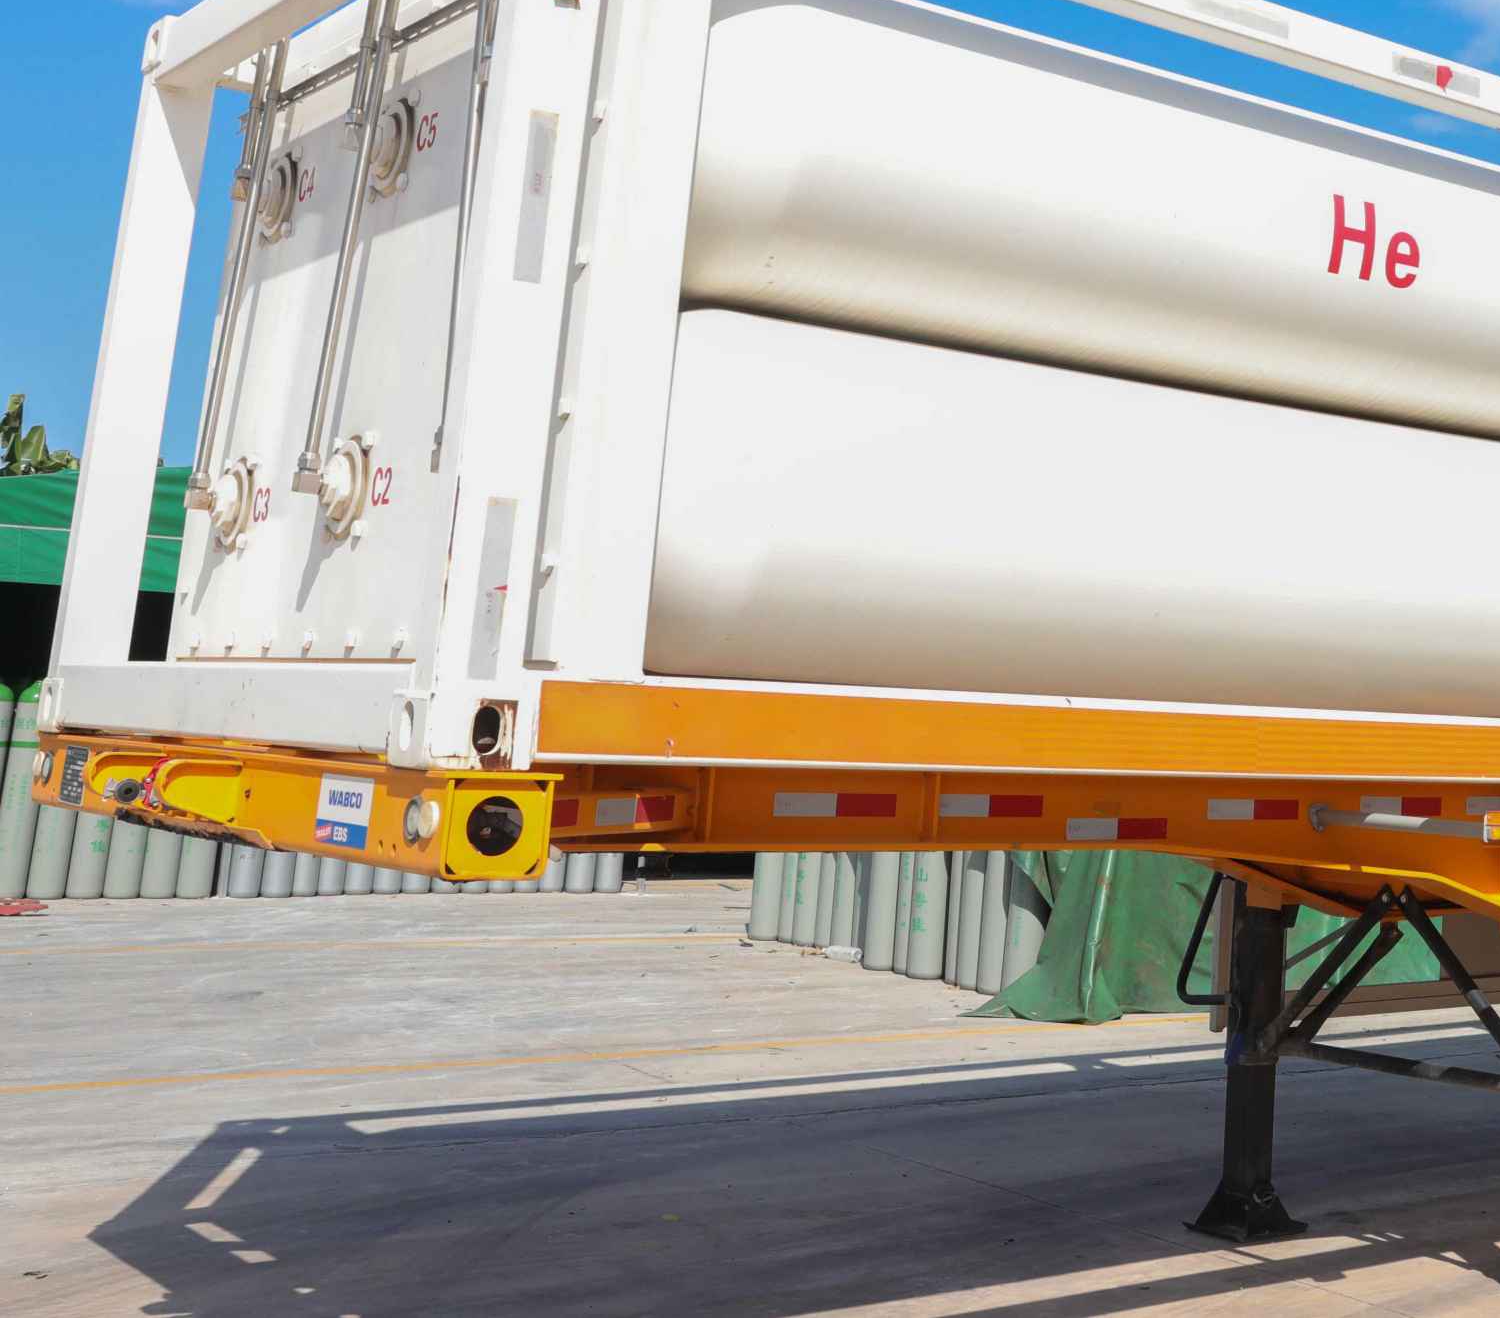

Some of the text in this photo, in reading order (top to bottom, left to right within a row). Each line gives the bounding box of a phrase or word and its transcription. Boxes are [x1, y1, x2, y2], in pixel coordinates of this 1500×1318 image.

[416, 112, 439, 152] C5
[298, 166, 316, 202] C4
[1327, 193, 1420, 289] He
[371, 466, 393, 507] C2
[252, 487, 271, 523] C3
[328, 789, 363, 809] WABCO
[333, 826, 348, 843] EBS
